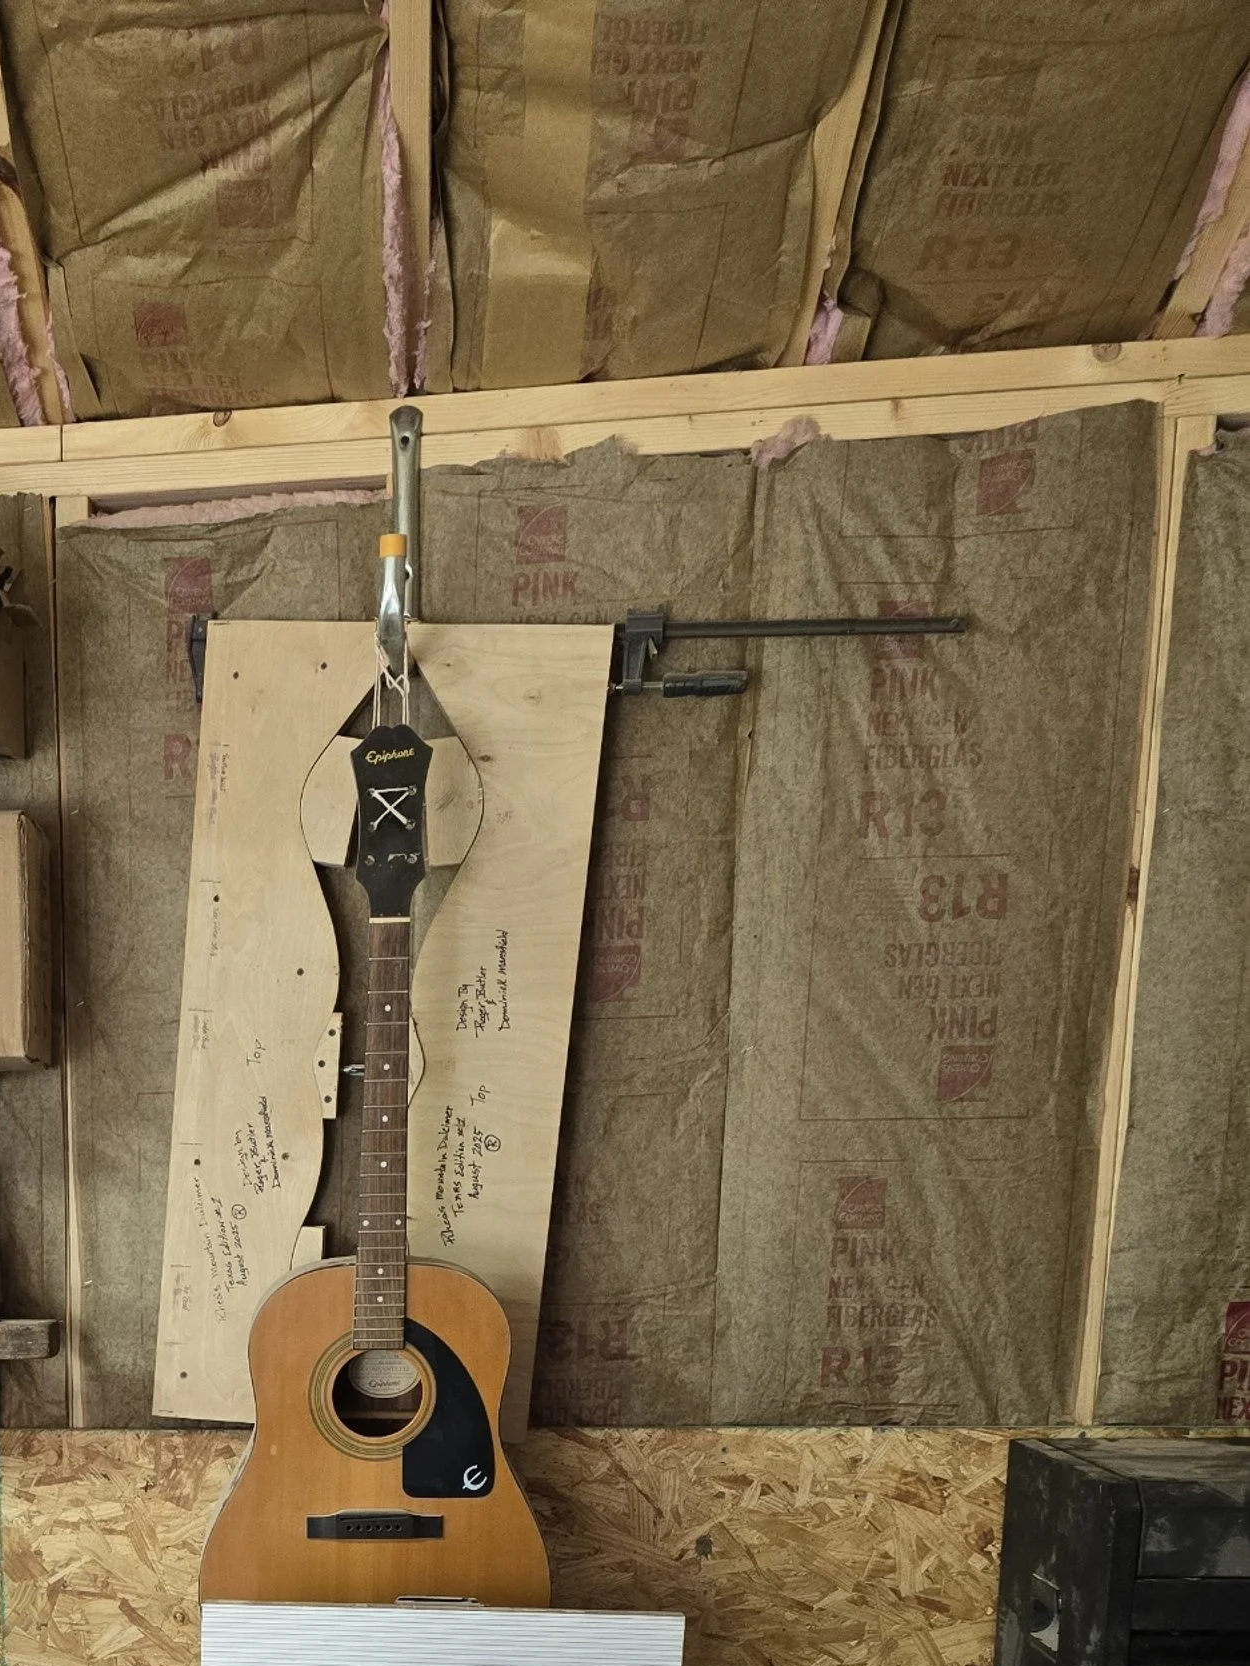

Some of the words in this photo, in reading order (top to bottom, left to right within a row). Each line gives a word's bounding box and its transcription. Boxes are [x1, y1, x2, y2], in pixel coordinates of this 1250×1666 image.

[916, 233, 1022, 270] R13
[512, 572, 579, 607] PINK
[870, 667, 938, 701] PINK
[365, 748, 415, 765] Epiphone
[857, 789, 947, 839] R13
[919, 874, 1009, 922] R13
[884, 941, 1004, 968] FIBERGLAS
[950, 973, 1002, 998] NEXT
[926, 1006, 998, 1041] PINK
[246, 1038, 266, 1066] Top
[470, 1085, 491, 1107] Top
[472, 1126, 485, 1157] 2025
[830, 1236, 899, 1268] PINK
